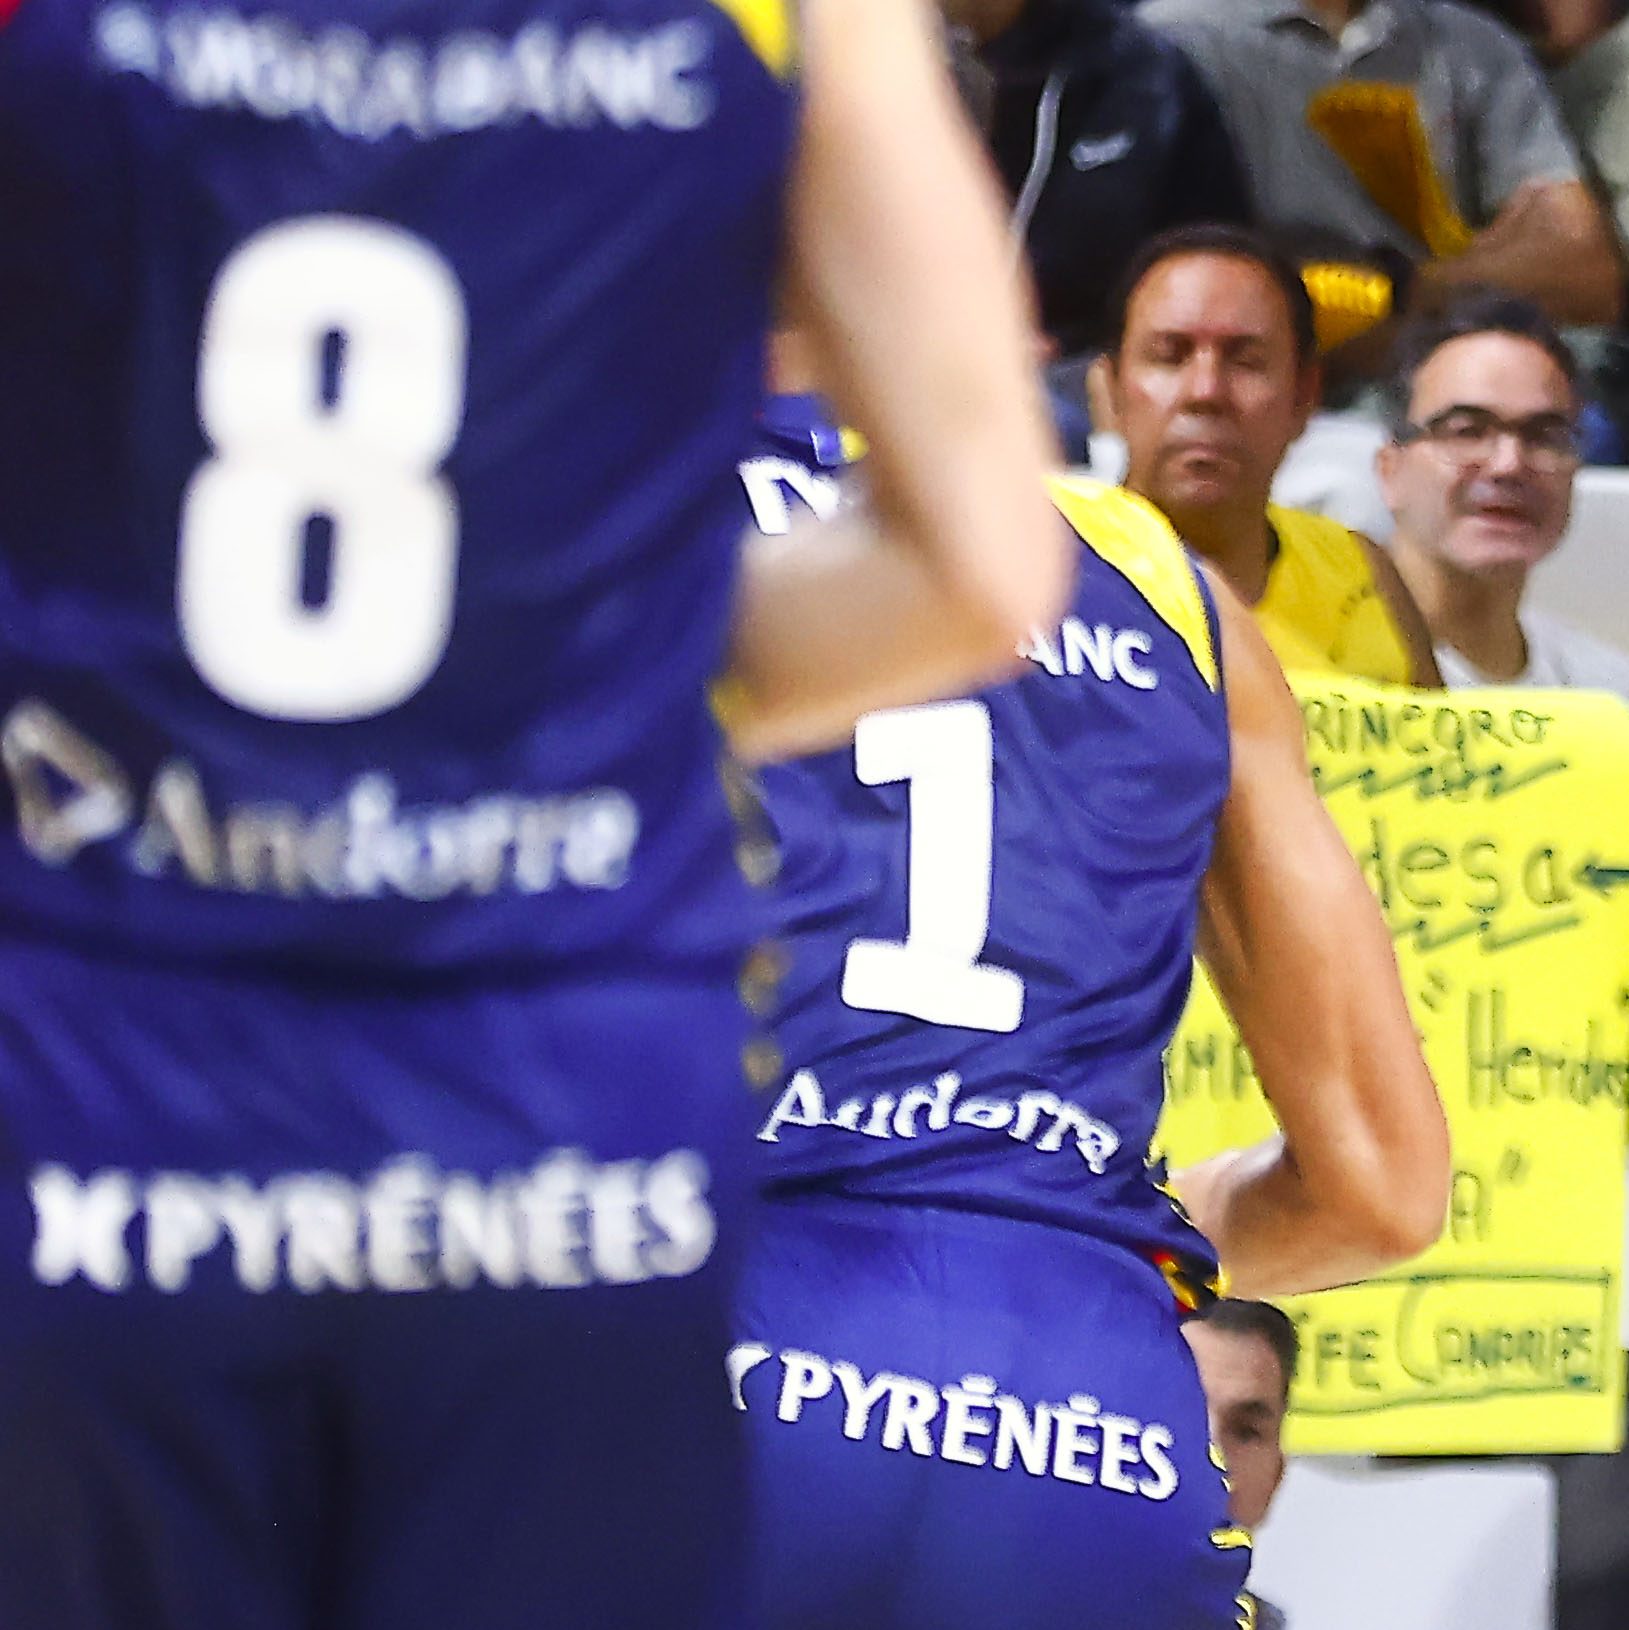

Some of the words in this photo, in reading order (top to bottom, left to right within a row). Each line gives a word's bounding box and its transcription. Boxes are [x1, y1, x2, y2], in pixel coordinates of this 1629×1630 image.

[178, 211, 468, 723] 8
[841, 698, 1025, 1033] 1
[1362, 818, 1572, 913] desa
